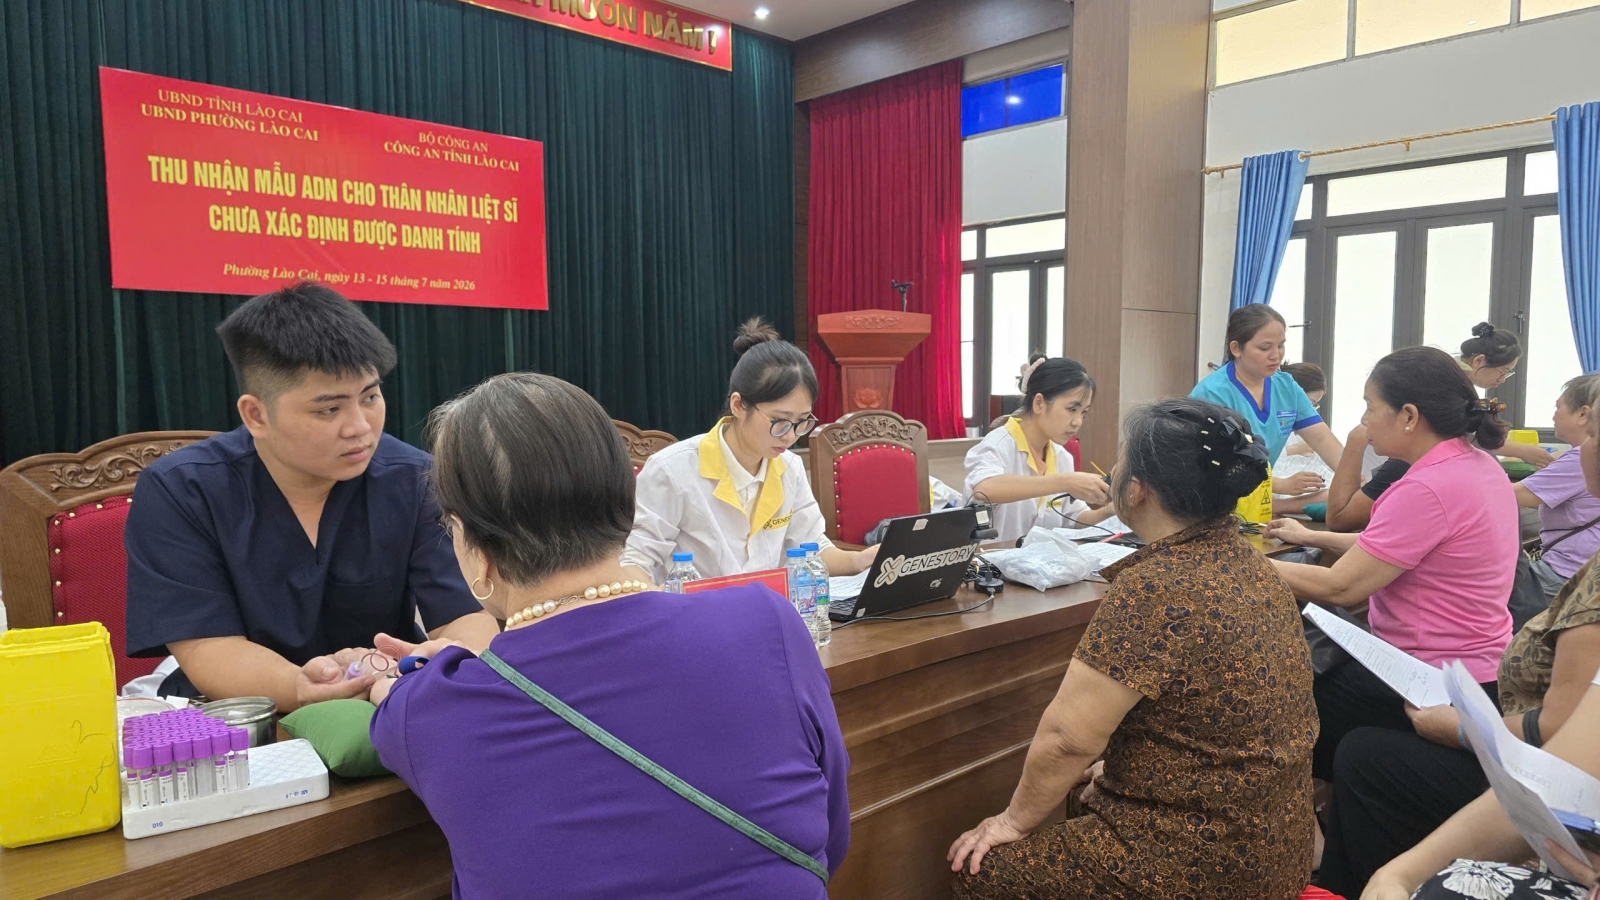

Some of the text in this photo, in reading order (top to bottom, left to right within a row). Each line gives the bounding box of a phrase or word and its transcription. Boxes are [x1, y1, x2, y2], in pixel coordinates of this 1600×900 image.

[643, 11, 704, 50] NĂM
[141, 103, 319, 141] UBND PHƯỜNG LÀO CAI
[158, 89, 303, 123] UBND TỈNH LÀO CAI
[384, 139, 520, 172] CÔNG AN TỈNH LÀO CAI
[418, 131, 489, 153] BỘ CÔNG AN
[147, 155, 518, 225] THU NHẬN MẪU ADN CHO THÂN NHÂN LIỆT SĨ
[209, 204, 481, 254] CHƯA XÁC ĐỊNH ĐƯỢC DANH TÍNH
[223, 263, 270, 280] Phường
[272, 266, 295, 279] Lào
[324, 271, 350, 285] ngày
[353, 272, 366, 284] 13
[376, 274, 388, 285] 15
[390, 275, 419, 290] tháng
[421, 276, 428, 288] 7
[430, 277, 451, 289] năm
[453, 279, 476, 291] 2026
[901, 545, 975, 573] GENESTORY
